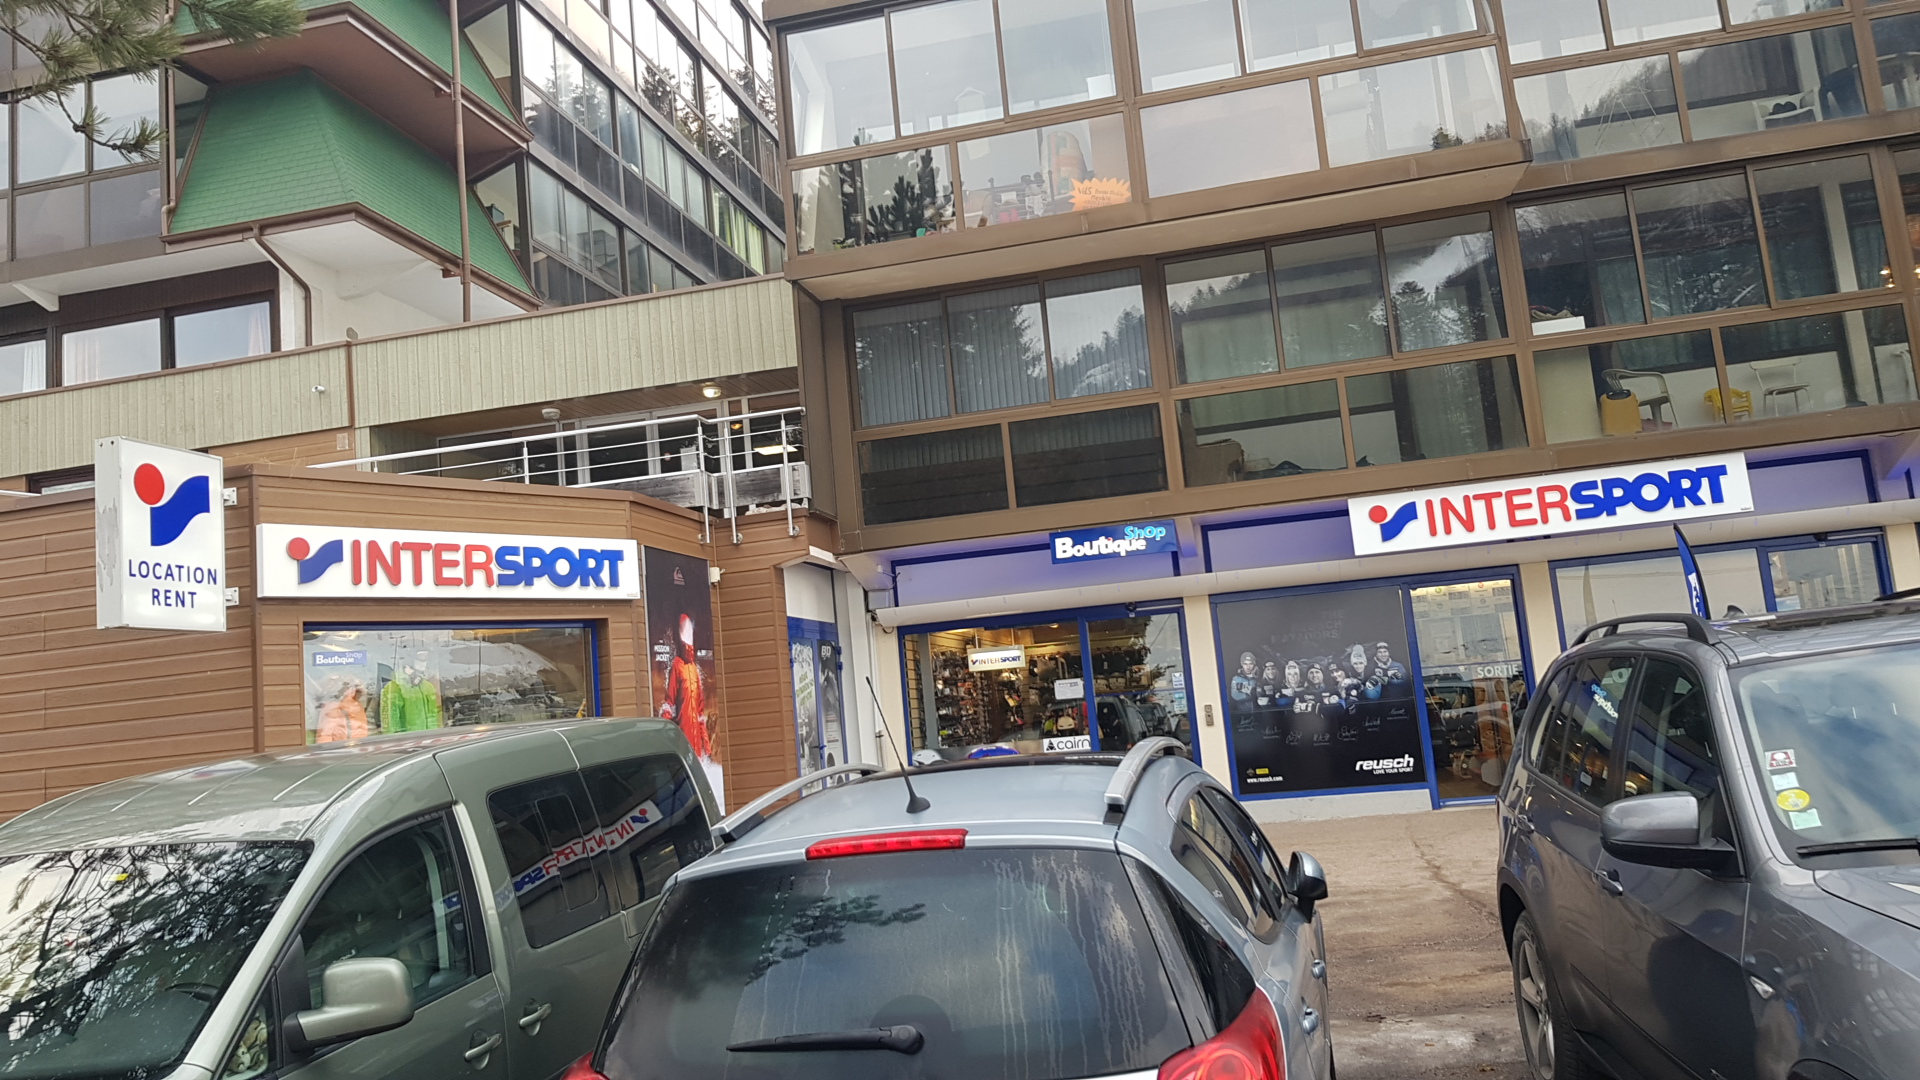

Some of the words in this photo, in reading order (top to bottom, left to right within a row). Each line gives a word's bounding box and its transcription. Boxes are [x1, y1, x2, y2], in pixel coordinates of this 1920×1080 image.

[1426, 464, 1727, 536] INTERSPORT
[1055, 536, 1147, 559] Boutique
[1124, 525, 1166, 541] Shop
[128, 559, 217, 585] LOCATION
[351, 539, 624, 588] INTERSPORT
[151, 588, 197, 609] RENT
[316, 654, 355, 665] Boutique
[978, 655, 1021, 665] INTERSPORT
[1477, 664, 1519, 678] SORTIE
[1058, 737, 1091, 751] cairn
[1355, 753, 1414, 771] reusch
[1246, 775, 1284, 784] www.reusch.com
